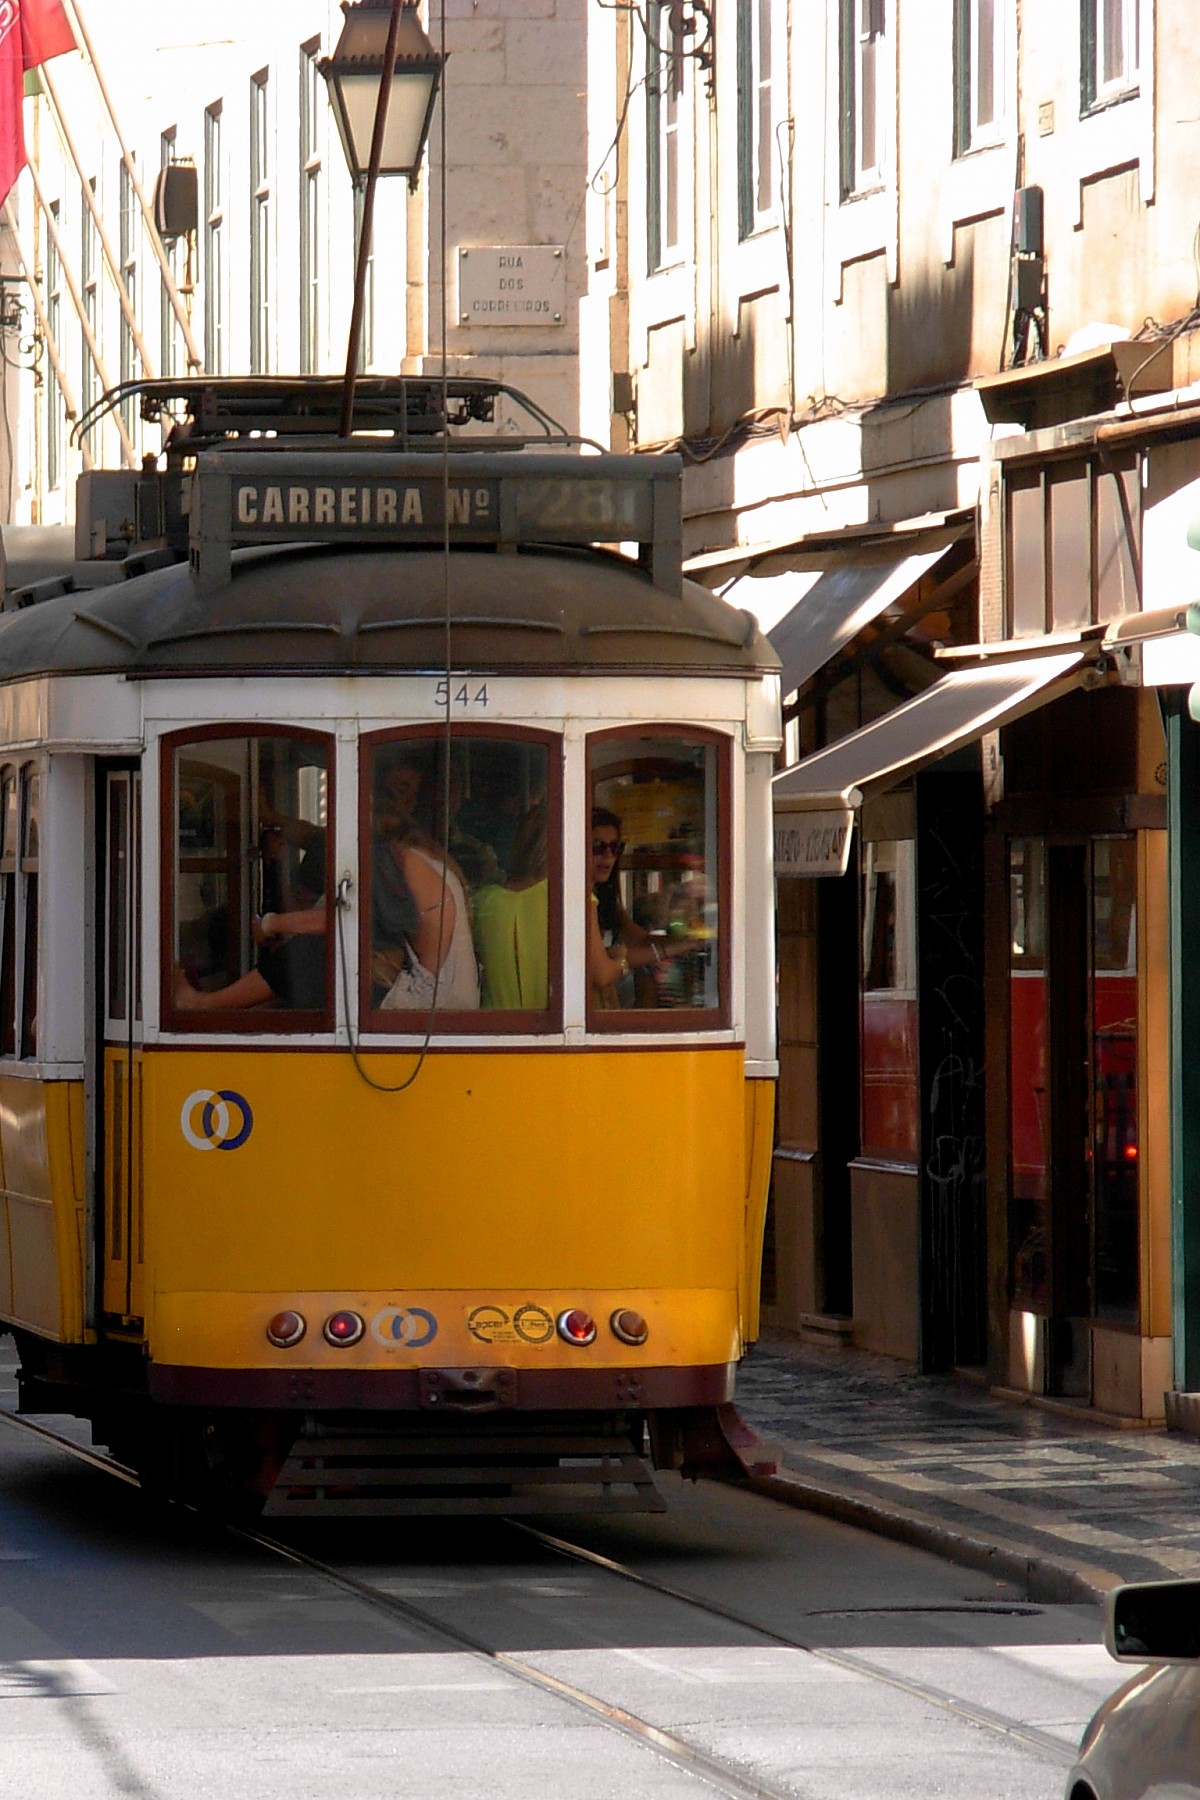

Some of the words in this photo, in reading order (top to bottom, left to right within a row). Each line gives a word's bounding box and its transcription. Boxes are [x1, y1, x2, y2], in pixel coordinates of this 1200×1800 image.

[499, 256, 523, 268] RUA
[499, 278, 524, 290] DOS
[238, 486, 424, 524] CARREIRA
[434, 681, 490, 707] 544
